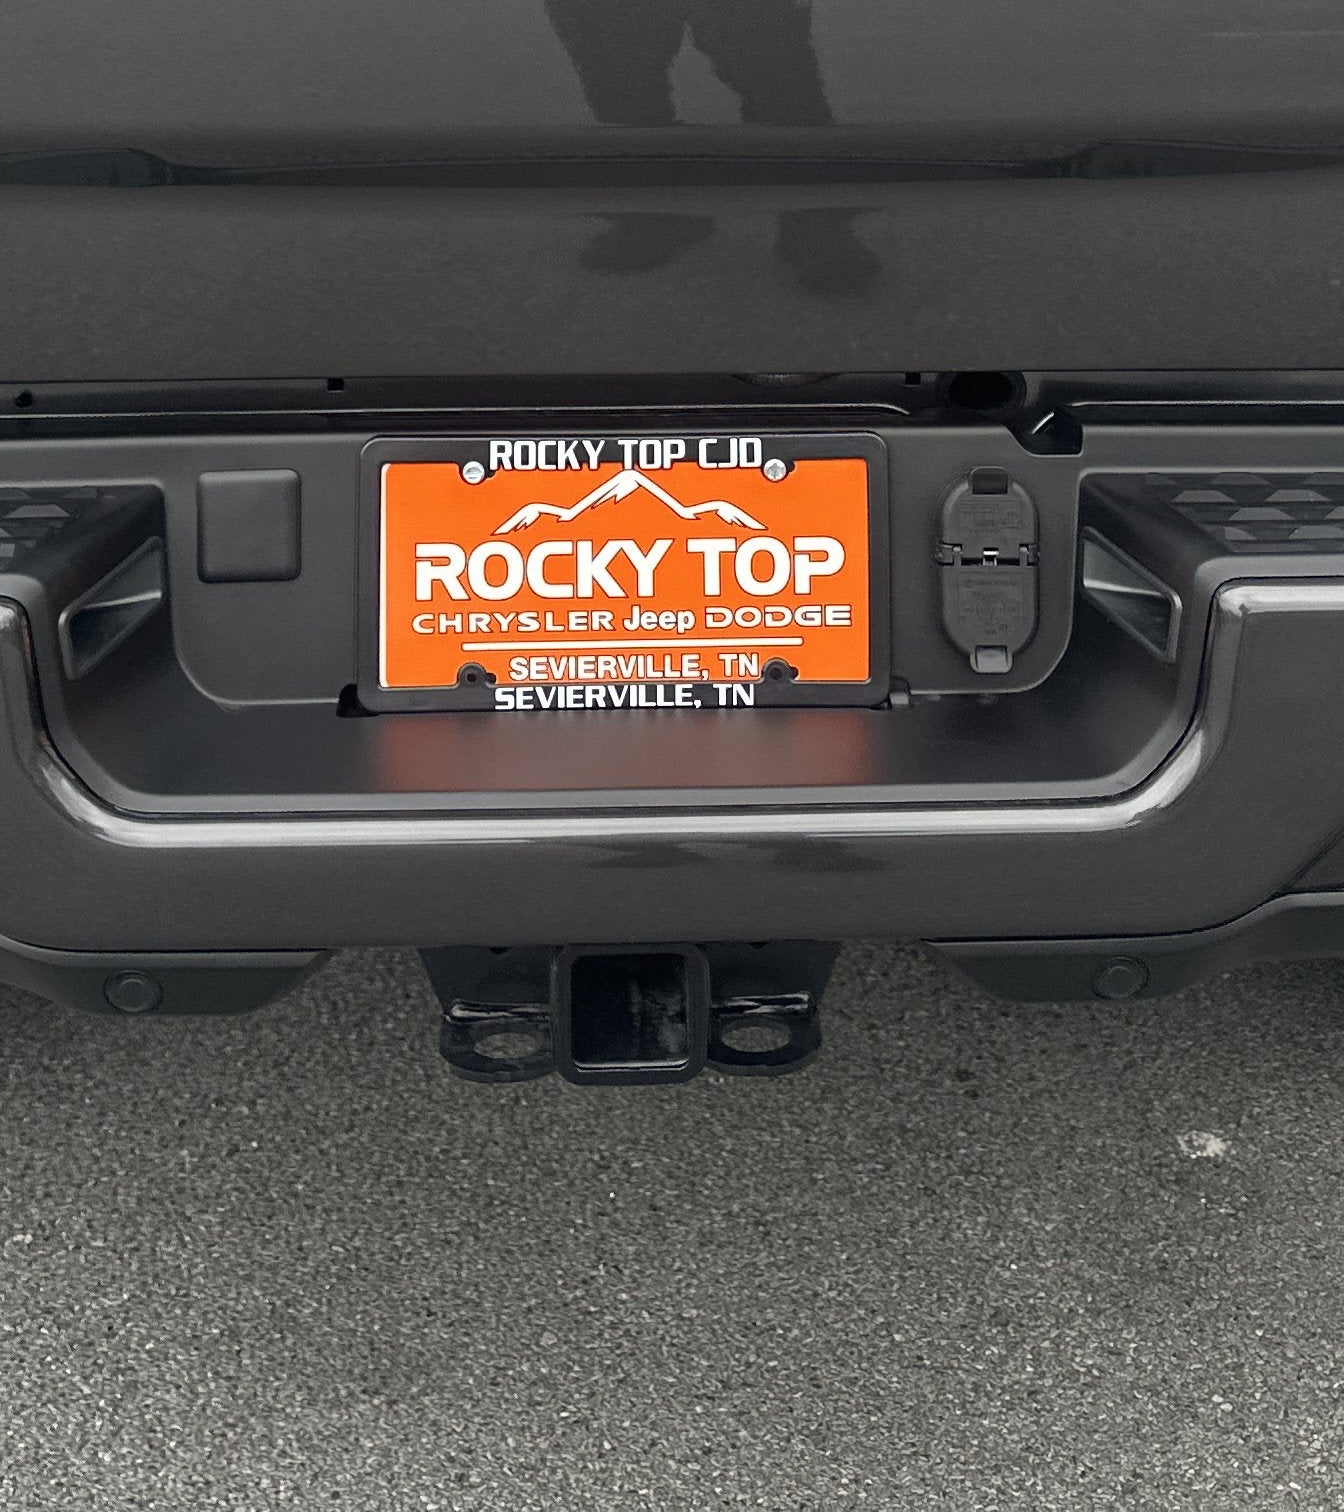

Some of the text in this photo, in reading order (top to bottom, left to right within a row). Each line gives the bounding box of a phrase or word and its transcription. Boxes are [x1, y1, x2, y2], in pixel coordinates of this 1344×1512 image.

[489, 437, 762, 471] ROCKY TOP CJD
[413, 536, 846, 601] ROCKY TOP
[411, 604, 853, 635] CHRYSLER Jeep DODGE
[508, 653, 759, 682] SEVIERVILLE, TN
[494, 685, 755, 710] SEVIERVILLE, TN
